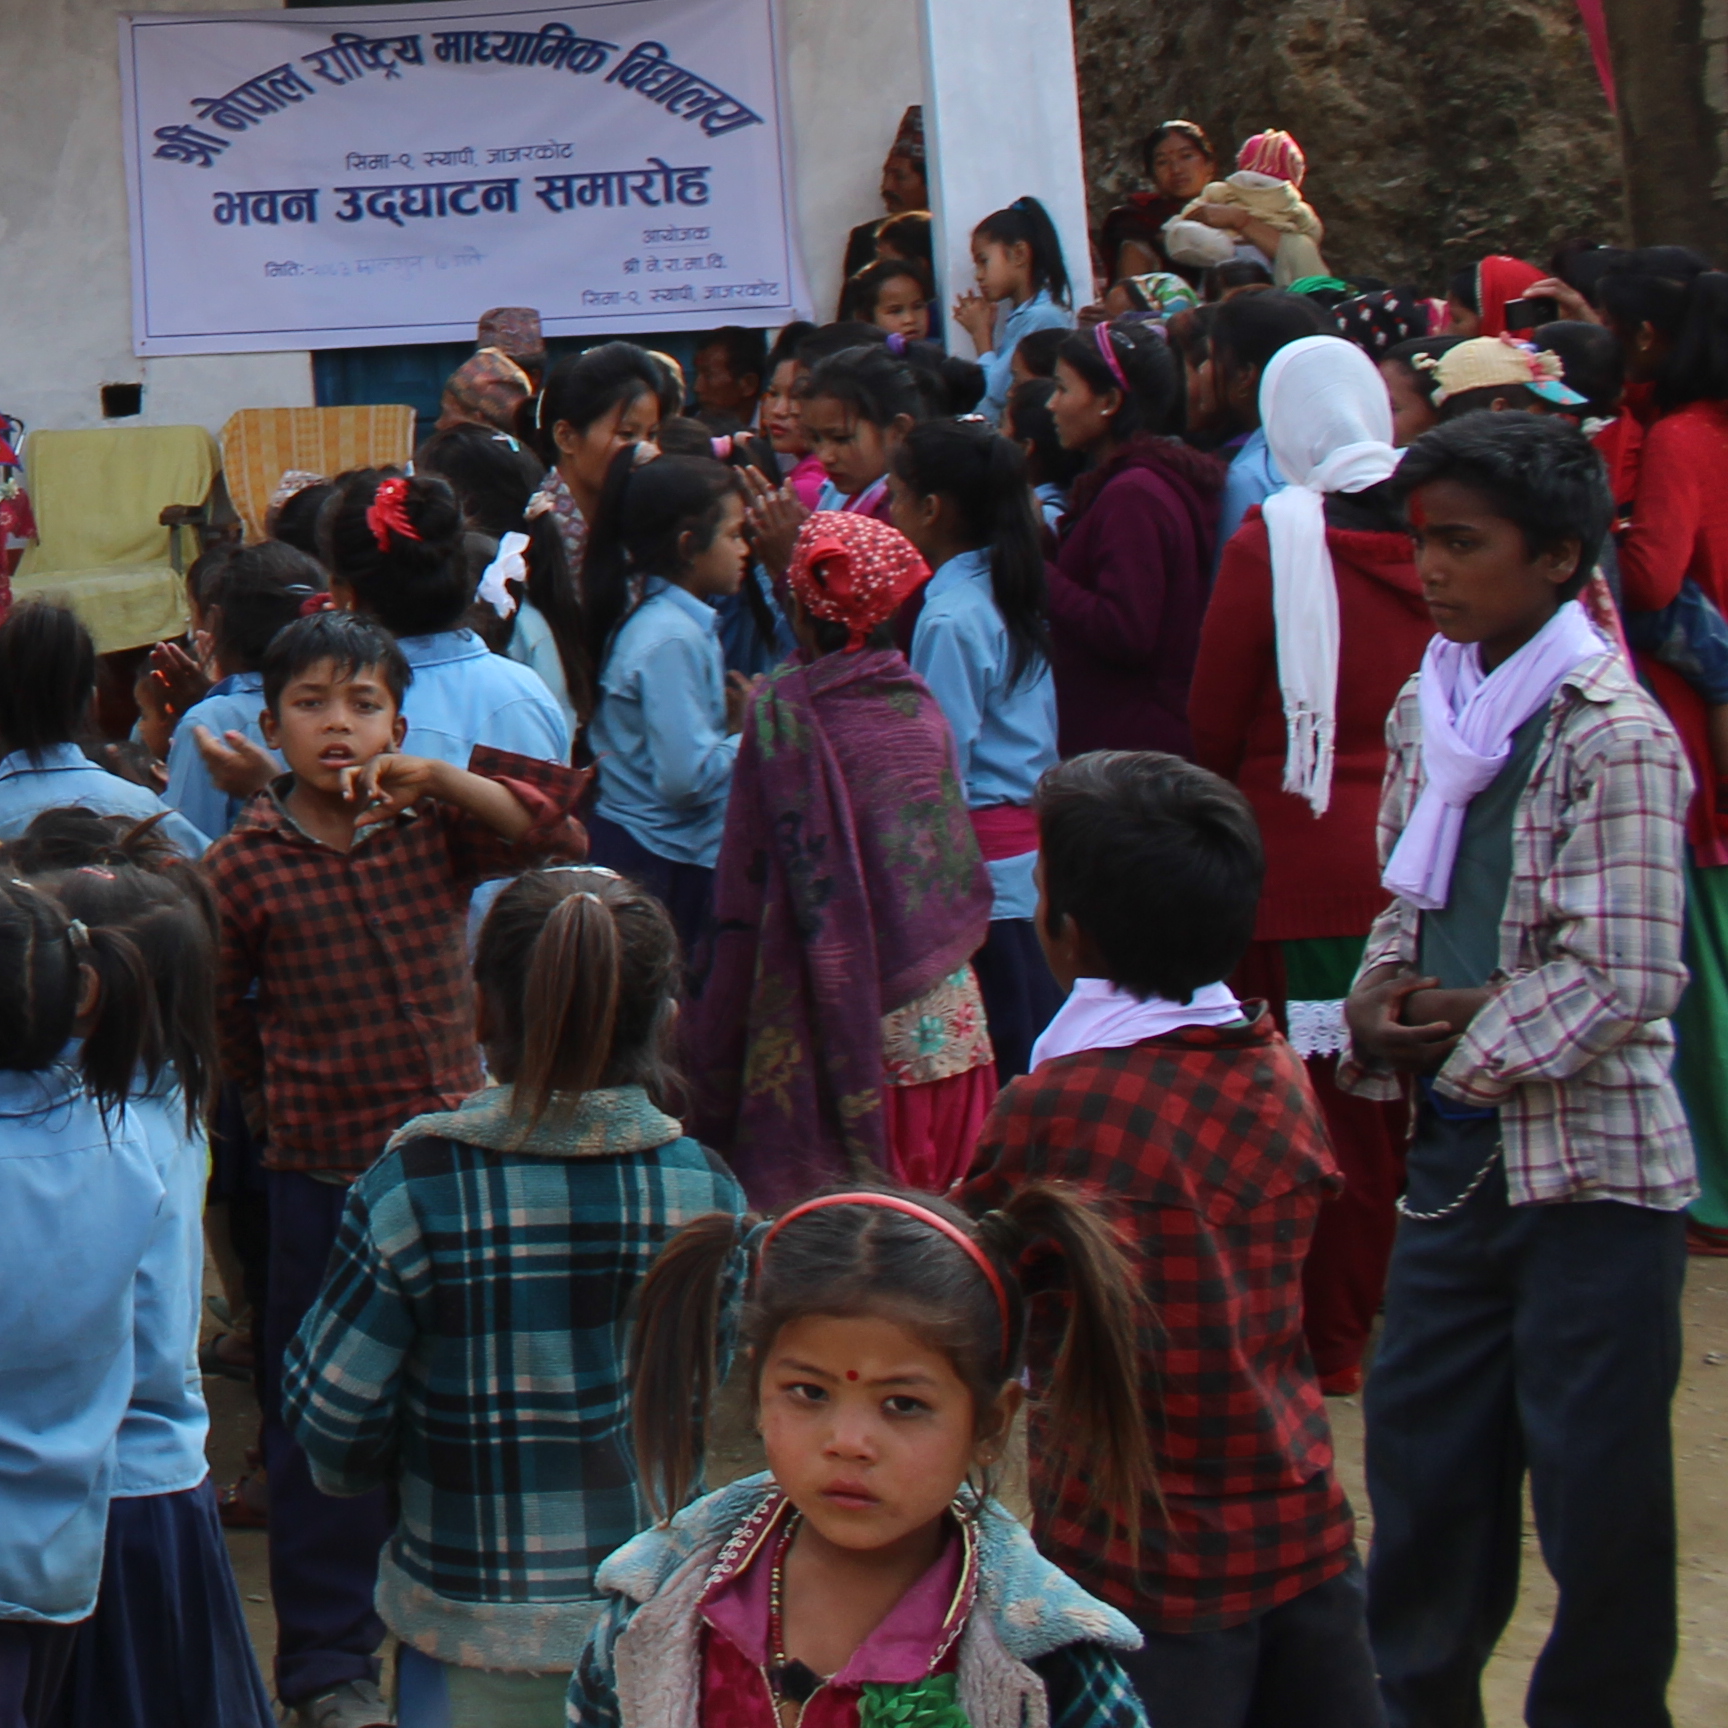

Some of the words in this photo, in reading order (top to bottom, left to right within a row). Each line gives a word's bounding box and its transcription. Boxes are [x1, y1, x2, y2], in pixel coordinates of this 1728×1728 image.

[191, 62, 316, 130] नेपाल
[604, 41, 764, 138] विद्यालय
[153, 124, 231, 167] श्री
[486, 139, 574, 165] जाजरकोट
[214, 188, 319, 227] भवन
[334, 177, 519, 227] उद्घाटन
[535, 157, 711, 213] समारोह
[643, 224, 711, 244] आयोजक
